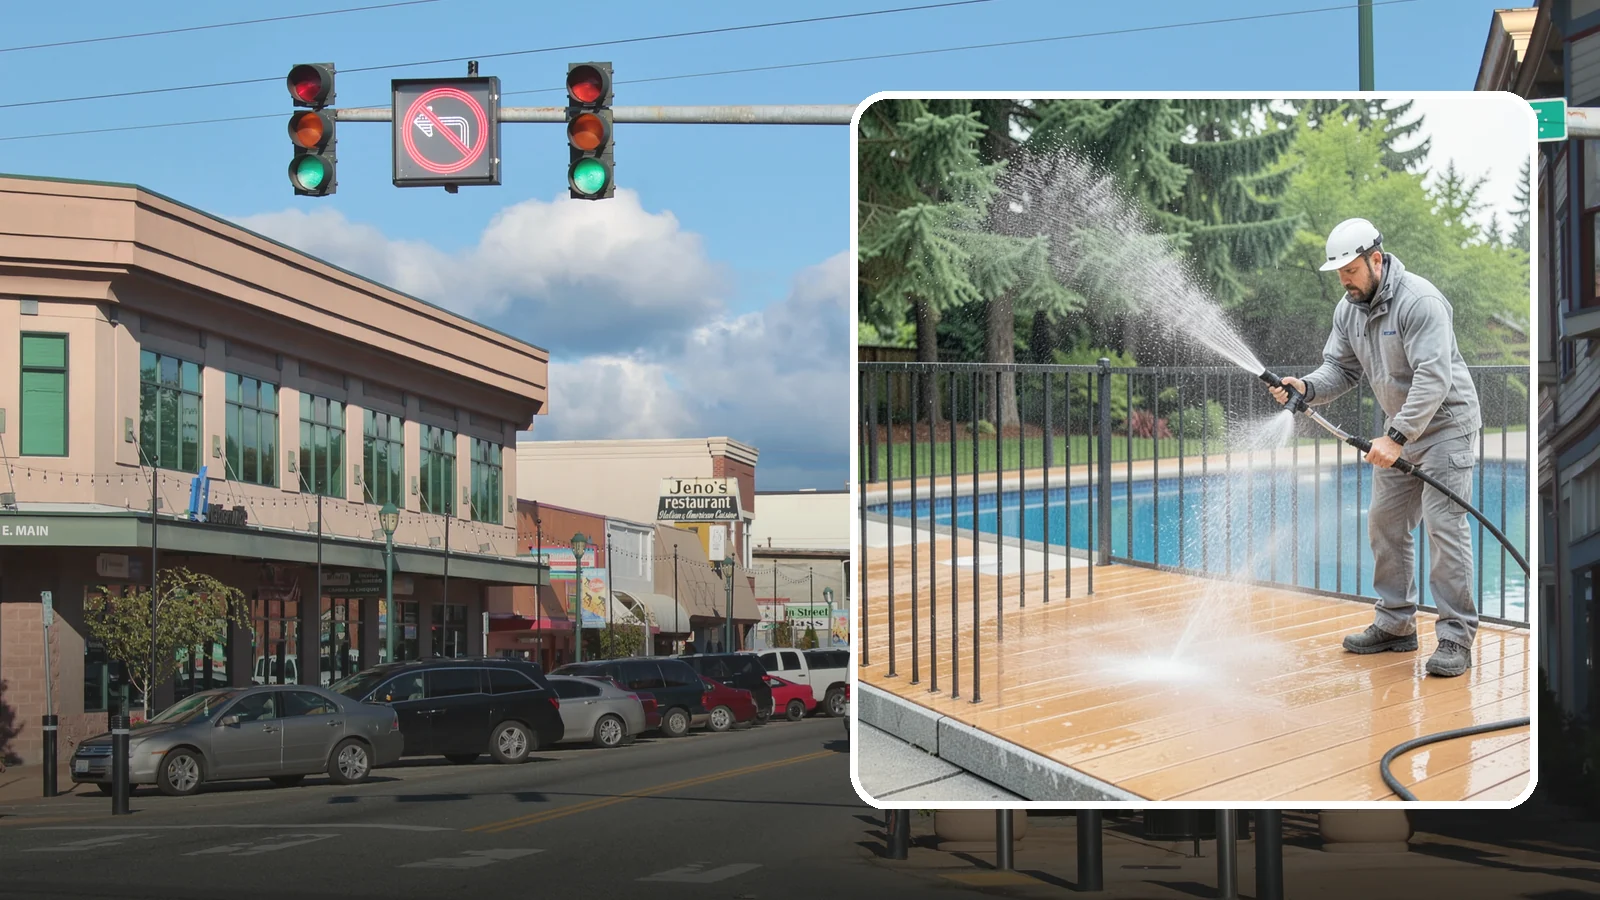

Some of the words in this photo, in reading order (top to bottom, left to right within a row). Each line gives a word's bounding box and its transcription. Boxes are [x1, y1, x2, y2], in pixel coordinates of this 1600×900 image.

[669, 480, 728, 494] Jeno's
[665, 496, 731, 509] restaurant
[686, 509, 715, 519] American
[715, 509, 737, 519] Cuisine
[2, 525, 13, 536] E.
[15, 525, 49, 536] MAIN
[797, 607, 828, 617] Street
